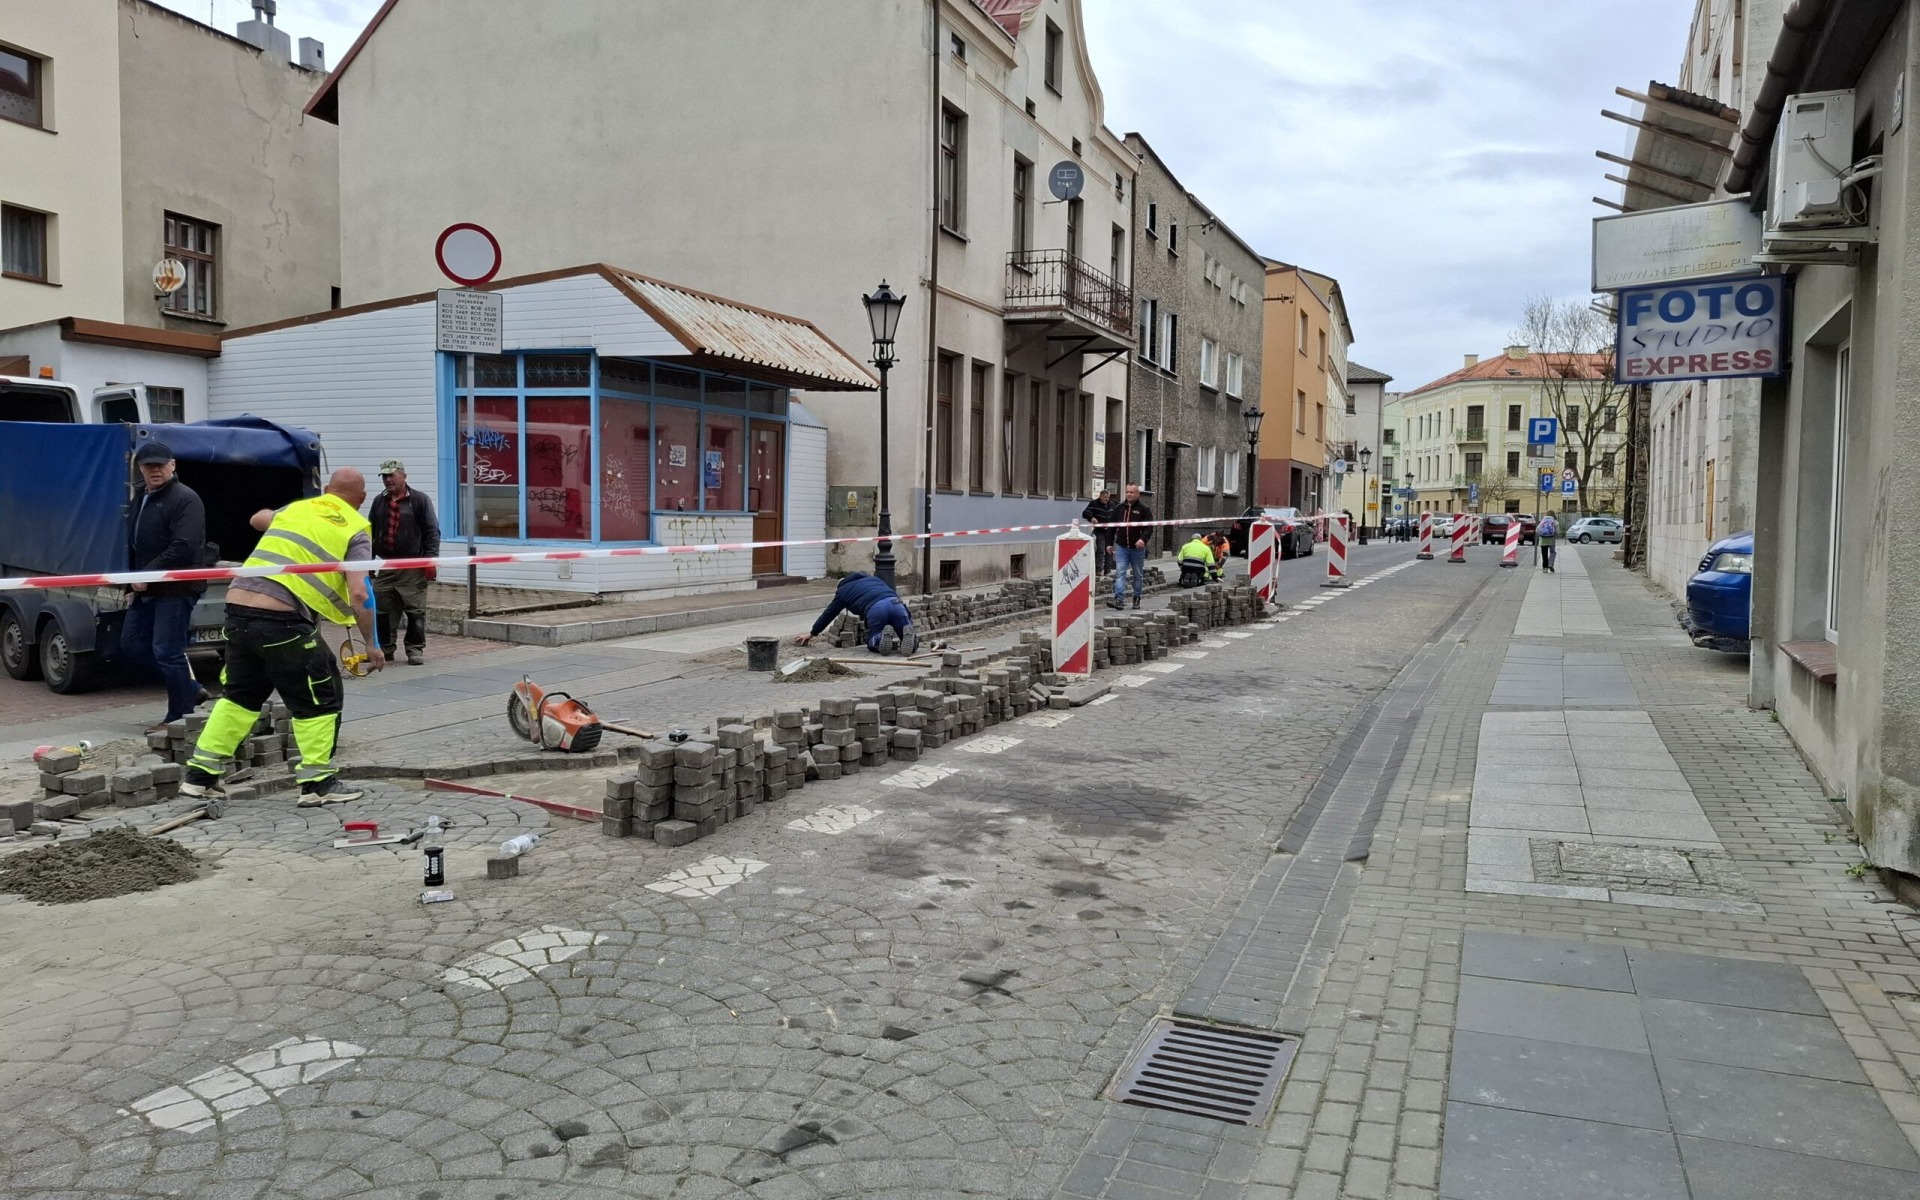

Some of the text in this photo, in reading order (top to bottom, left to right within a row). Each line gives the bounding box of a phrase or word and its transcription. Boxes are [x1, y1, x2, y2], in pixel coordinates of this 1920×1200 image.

[1642, 240, 1742, 257] AUTORYZOWANY PARTNER
[1606, 257, 1752, 282] WWW.NETICO.PL
[1626, 283, 1774, 326] FOTO
[1629, 318, 1773, 354] STUDIO
[1626, 350, 1773, 377] EXPRESS
[1534, 420, 1551, 441] P
[1544, 475, 1551, 486] P
[1564, 482, 1572, 491] P
